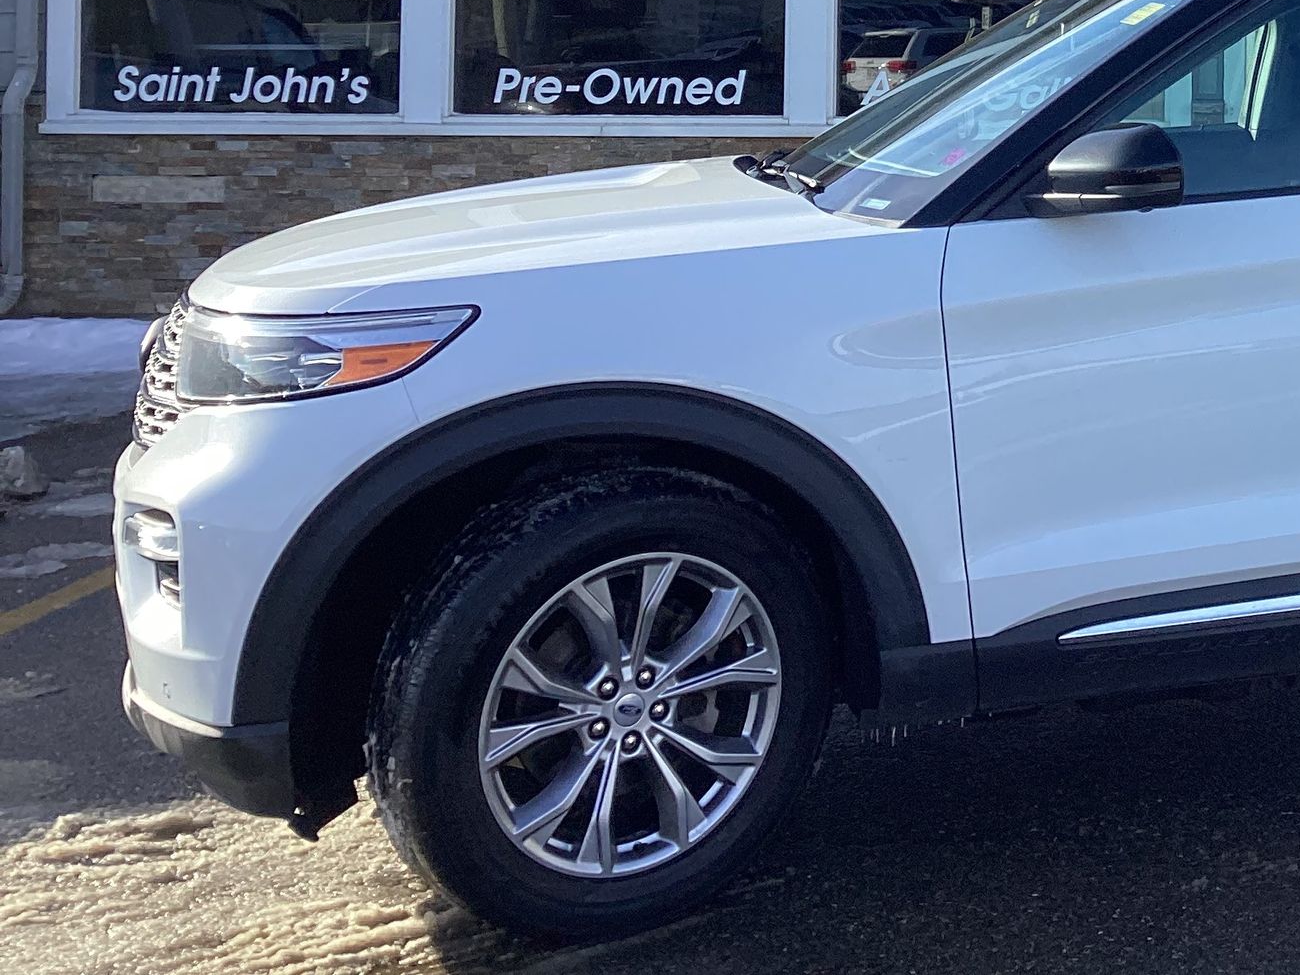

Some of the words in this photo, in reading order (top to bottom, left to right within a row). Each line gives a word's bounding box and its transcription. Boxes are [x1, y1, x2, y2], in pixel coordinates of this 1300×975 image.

[114, 65, 221, 102] Saint
[229, 67, 369, 104] John's
[493, 68, 747, 105] Pre-Owned
